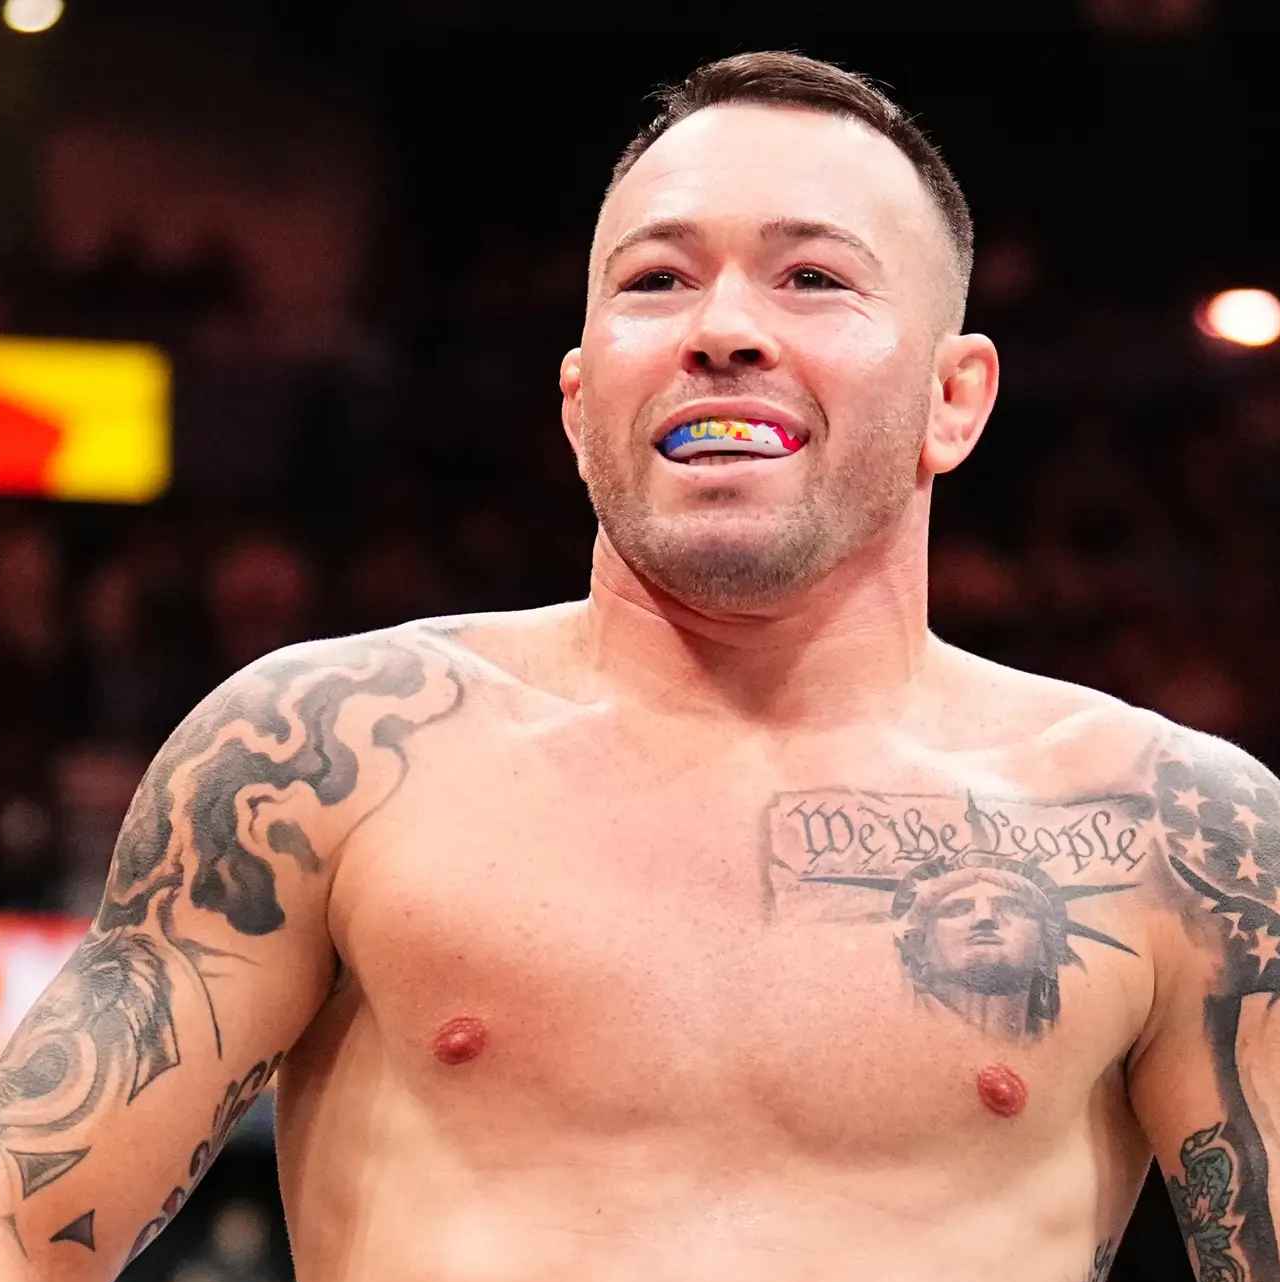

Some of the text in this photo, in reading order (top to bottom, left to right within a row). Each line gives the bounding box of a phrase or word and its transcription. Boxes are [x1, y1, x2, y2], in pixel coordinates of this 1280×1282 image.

[689, 419, 752, 440] USA
[786, 800, 887, 865] We
[964, 806, 1146, 875] People
